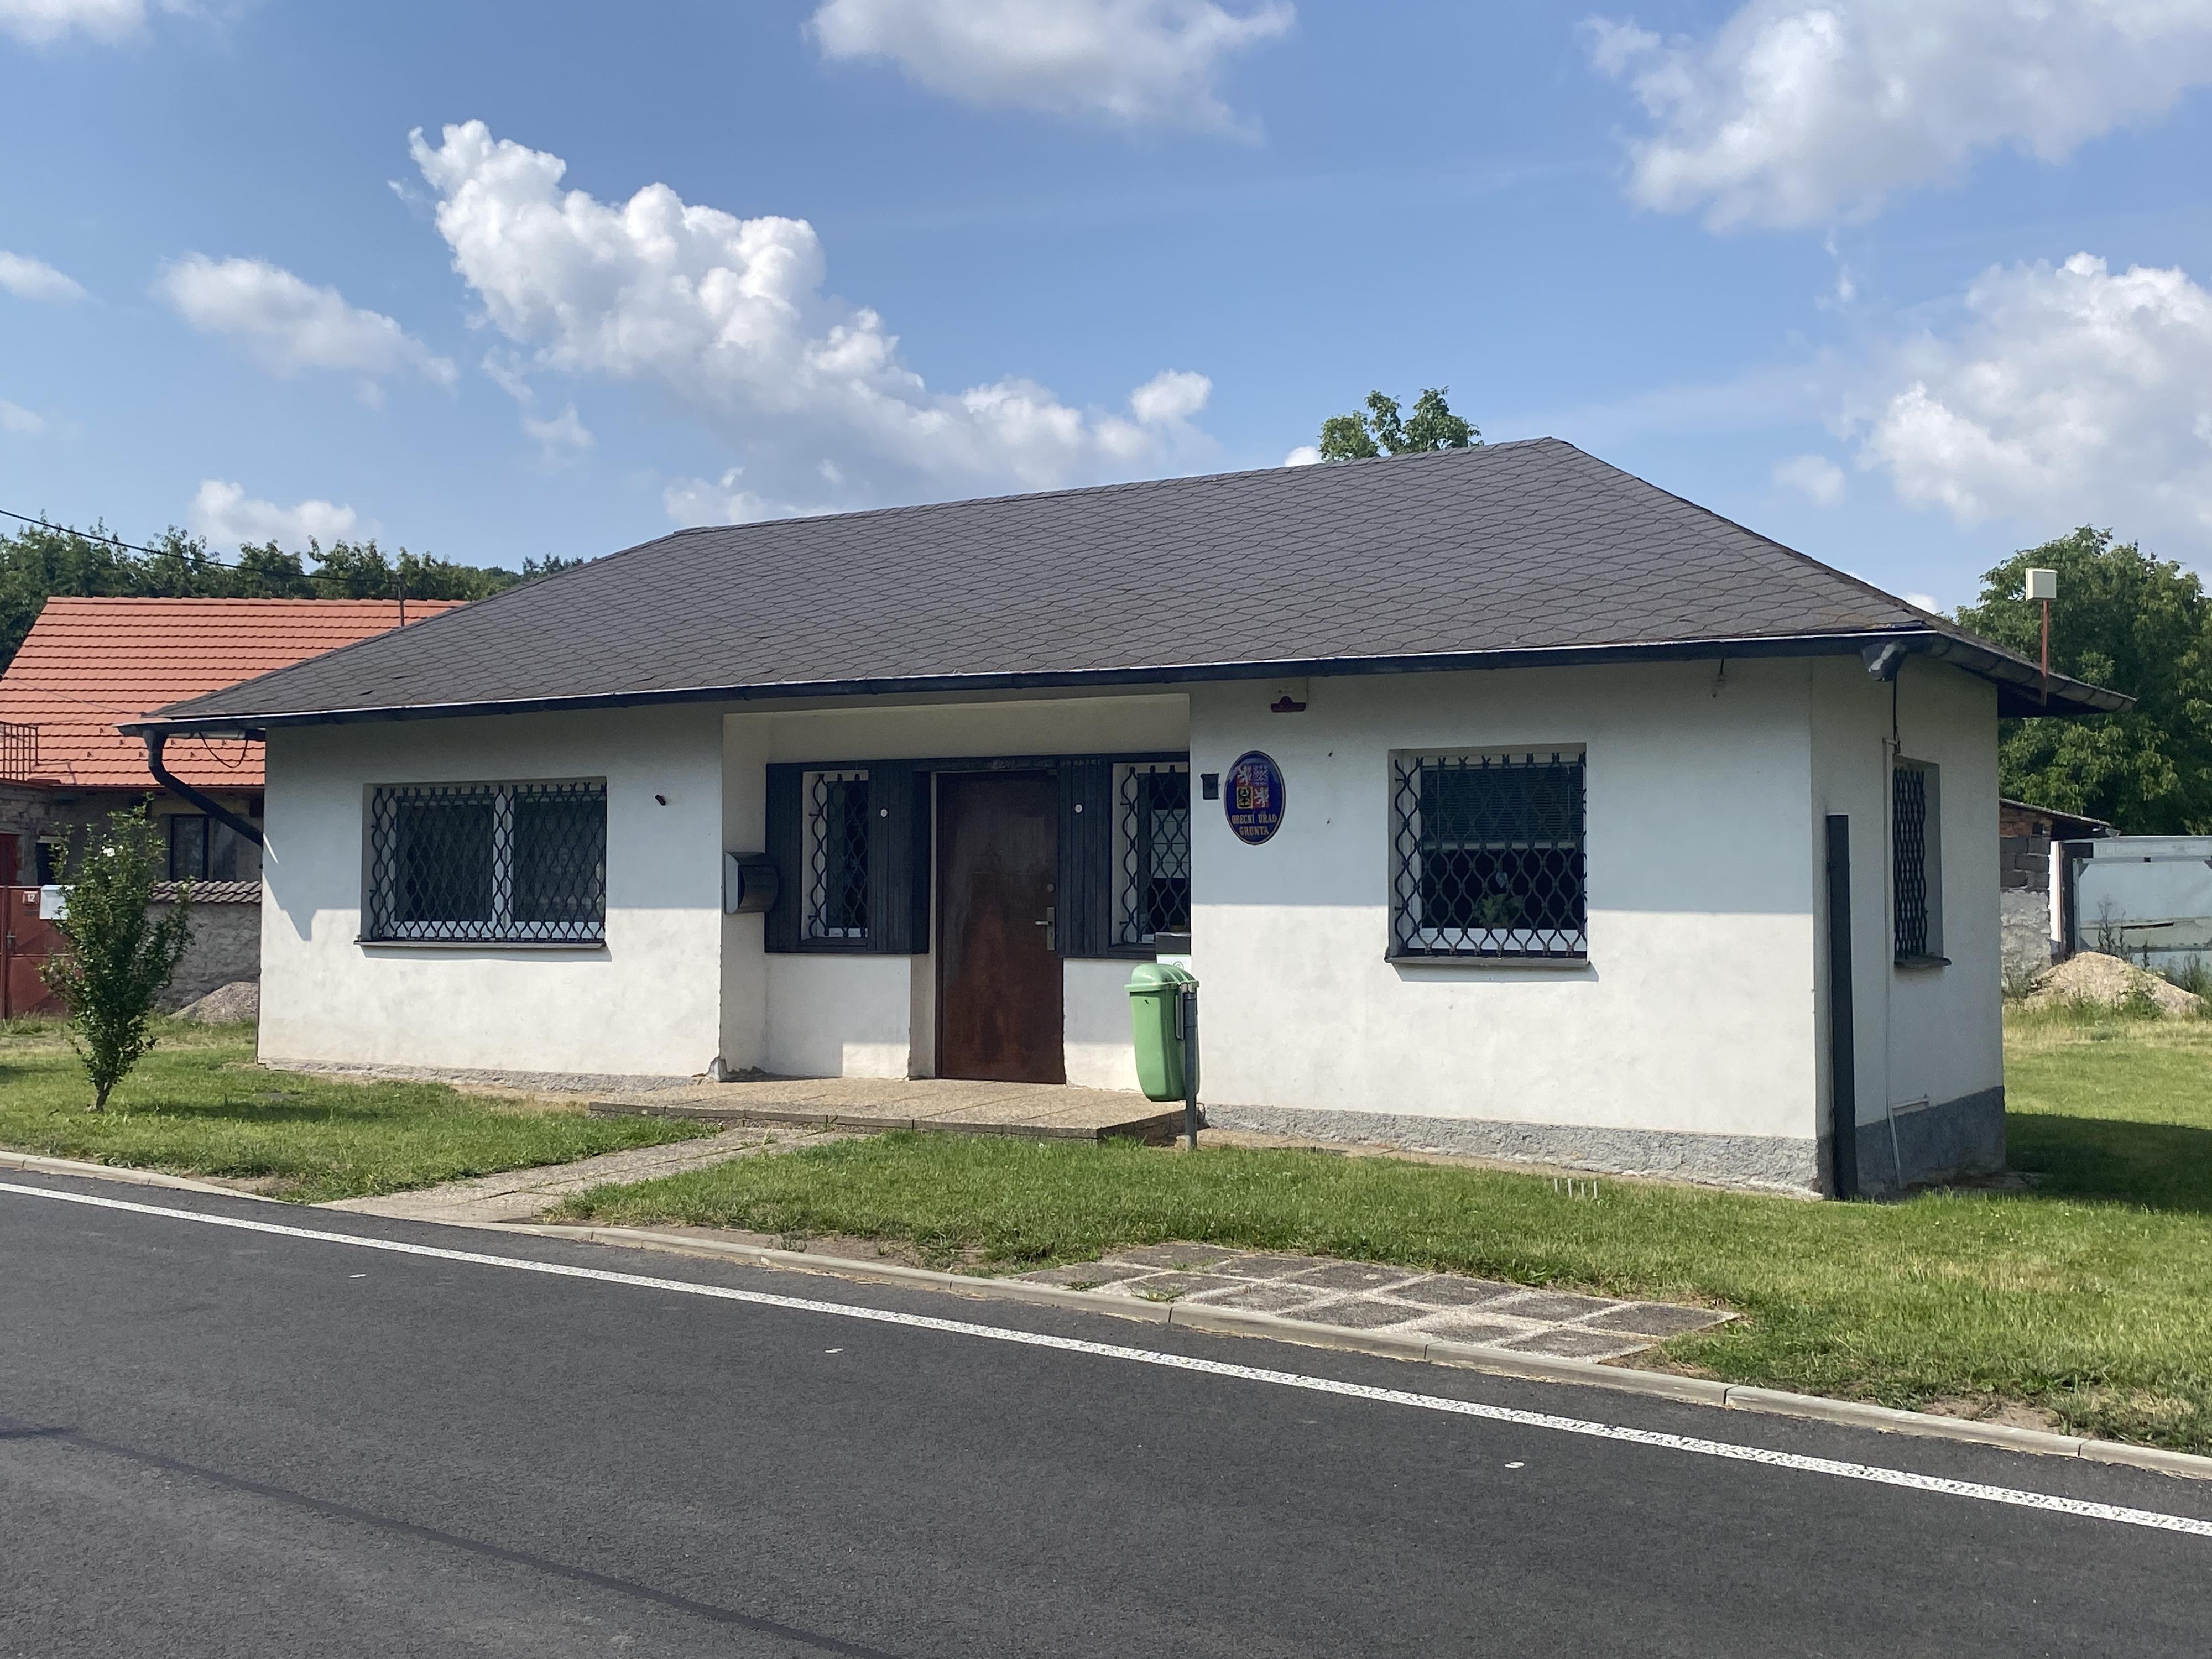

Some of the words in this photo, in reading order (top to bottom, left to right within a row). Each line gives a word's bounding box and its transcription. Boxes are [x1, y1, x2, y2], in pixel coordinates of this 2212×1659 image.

[1232, 811, 1255, 824] OBECNÍ
[1258, 811, 1277, 823] ÚŘAD
[1239, 826, 1270, 836] GRUNTA
[28, 894, 35, 902] 12
